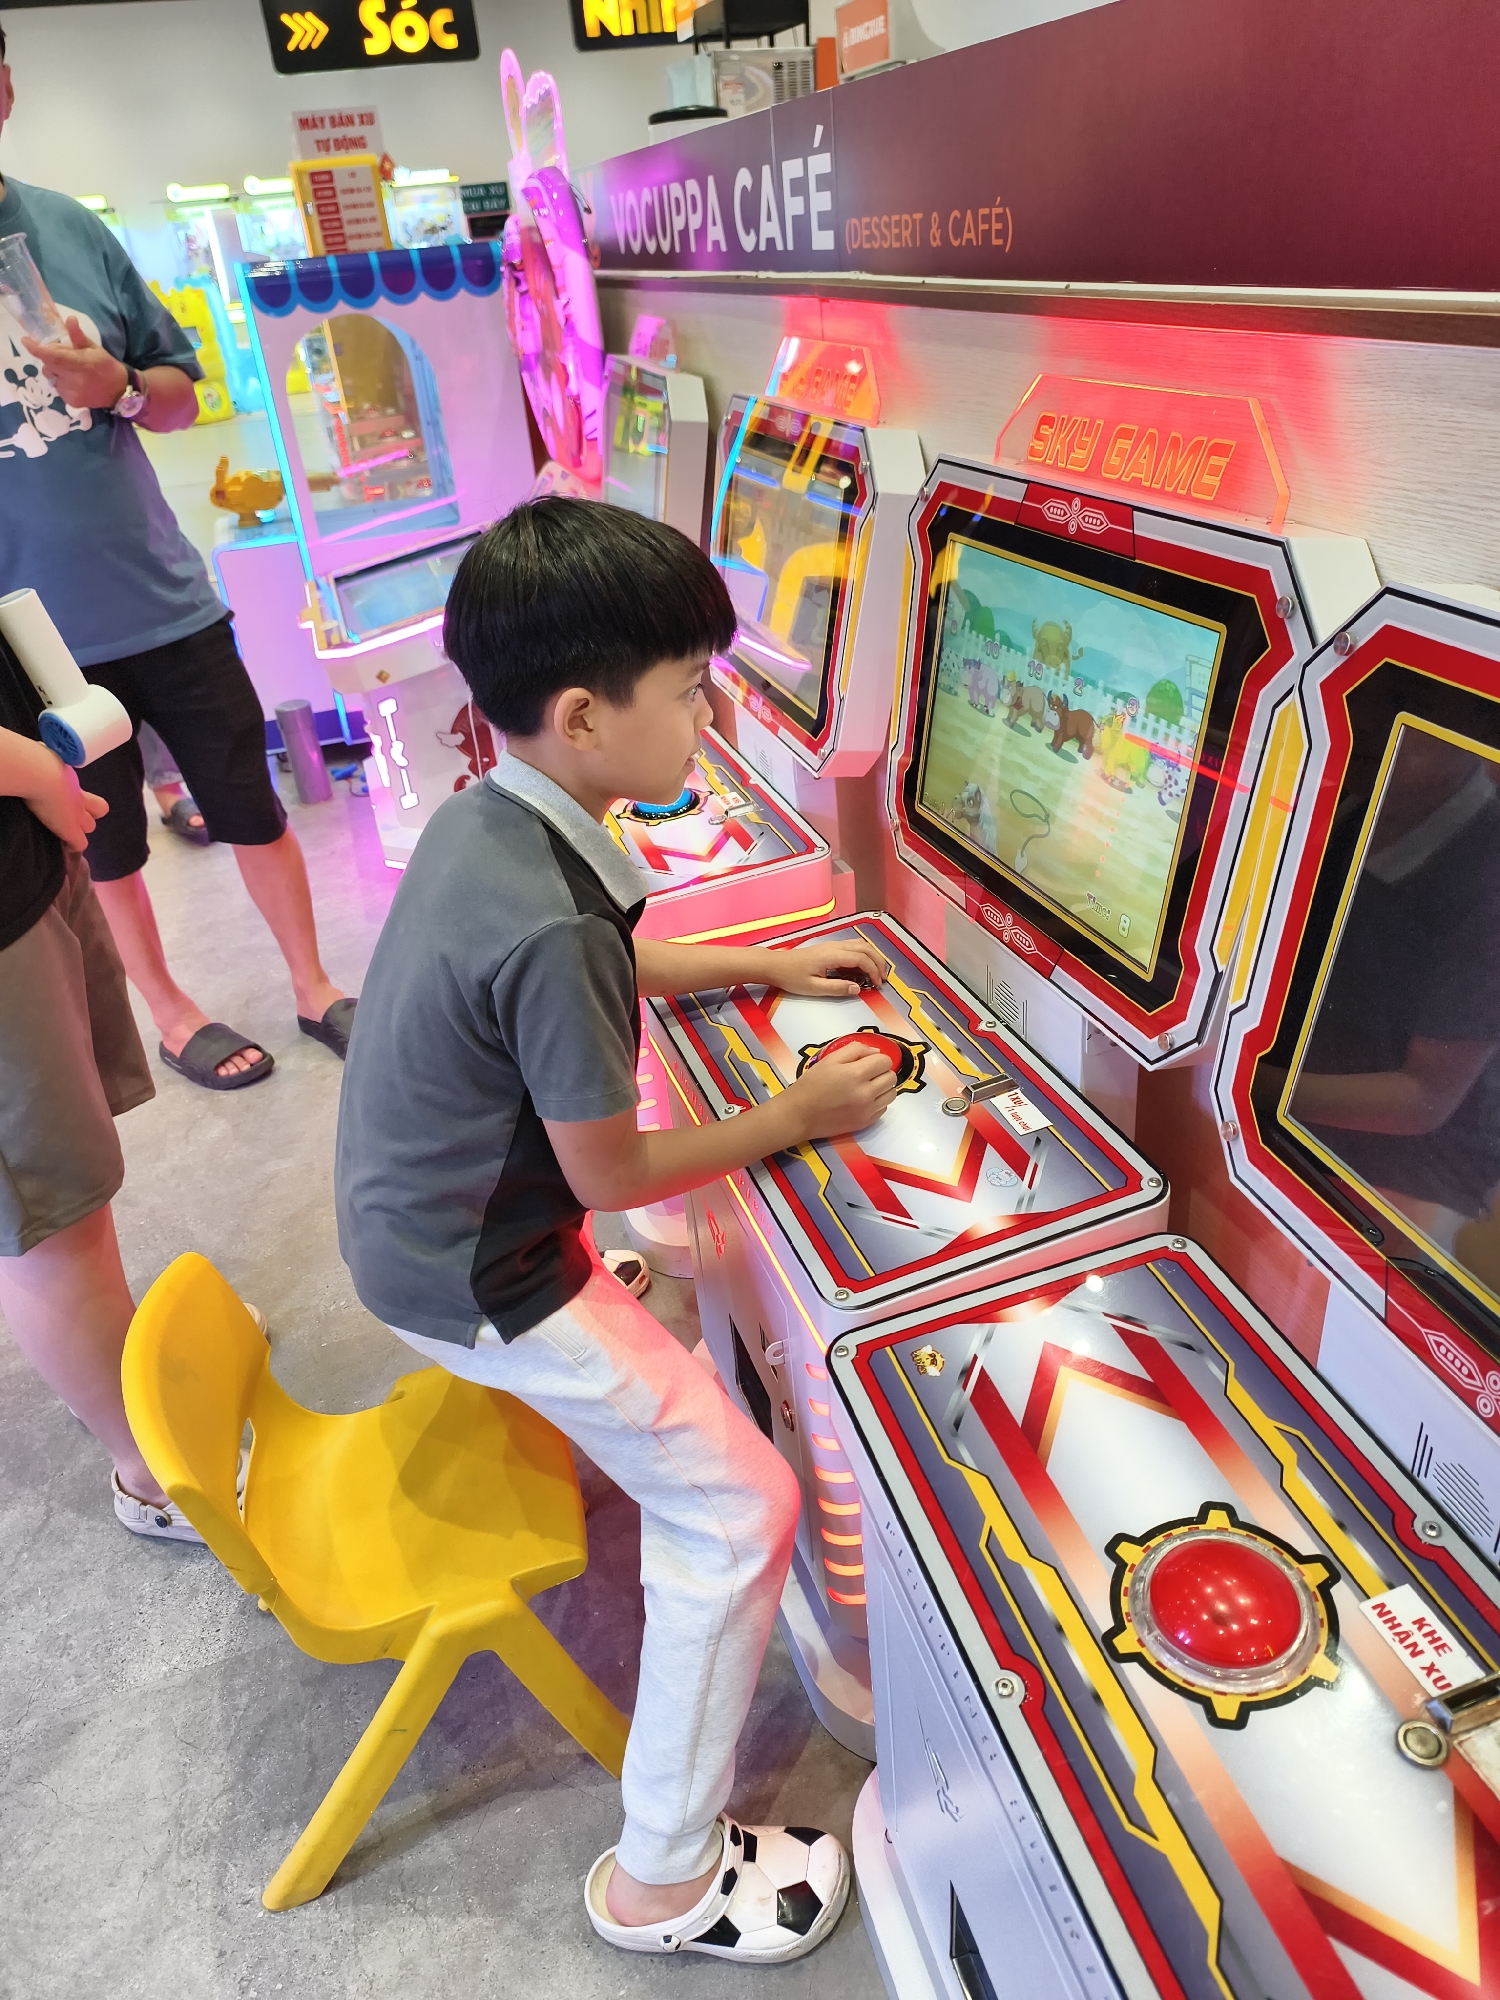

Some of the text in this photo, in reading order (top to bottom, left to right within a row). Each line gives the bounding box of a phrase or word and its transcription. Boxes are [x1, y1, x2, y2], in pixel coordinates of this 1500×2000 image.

[358, 0, 459, 55] Sóc
[328, 112, 355, 129] BÁN
[356, 112, 376, 127] XU
[610, 124, 835, 255] VOCUPPA CAFÉ
[845, 196, 1013, 255] (DESSERT & CAFÉ)
[1027, 411, 1237, 501] SKY GAME
[985, 640, 1000, 659] 10
[1027, 660, 1044, 680] 19
[1086, 891, 1131, 938] Time: 8
[1370, 1602, 1454, 1692] NHẬN XU
[1411, 1617, 1453, 1657] KHE
